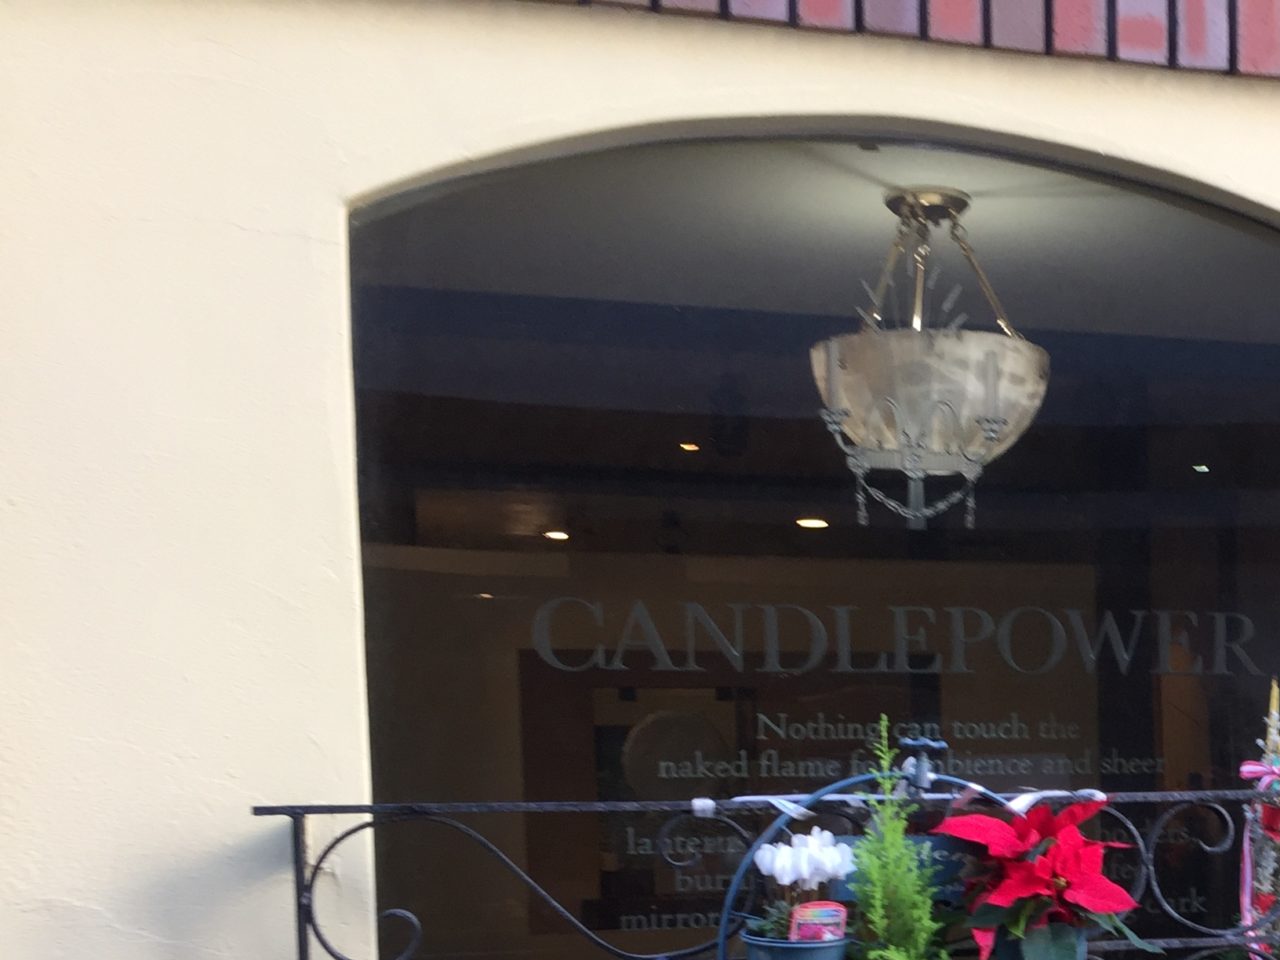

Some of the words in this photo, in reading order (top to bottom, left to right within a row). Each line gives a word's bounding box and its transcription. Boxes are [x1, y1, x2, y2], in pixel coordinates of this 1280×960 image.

[530, 596, 1267, 677] CANDLEPOWER
[757, 712, 881, 748] Nothing
[893, 719, 942, 740] can
[952, 713, 1030, 740] touch
[1038, 713, 1081, 739] the
[657, 750, 749, 779] naked
[759, 749, 841, 778] flame
[1042, 752, 1094, 776] and
[1101, 748, 1165, 775] sheer
